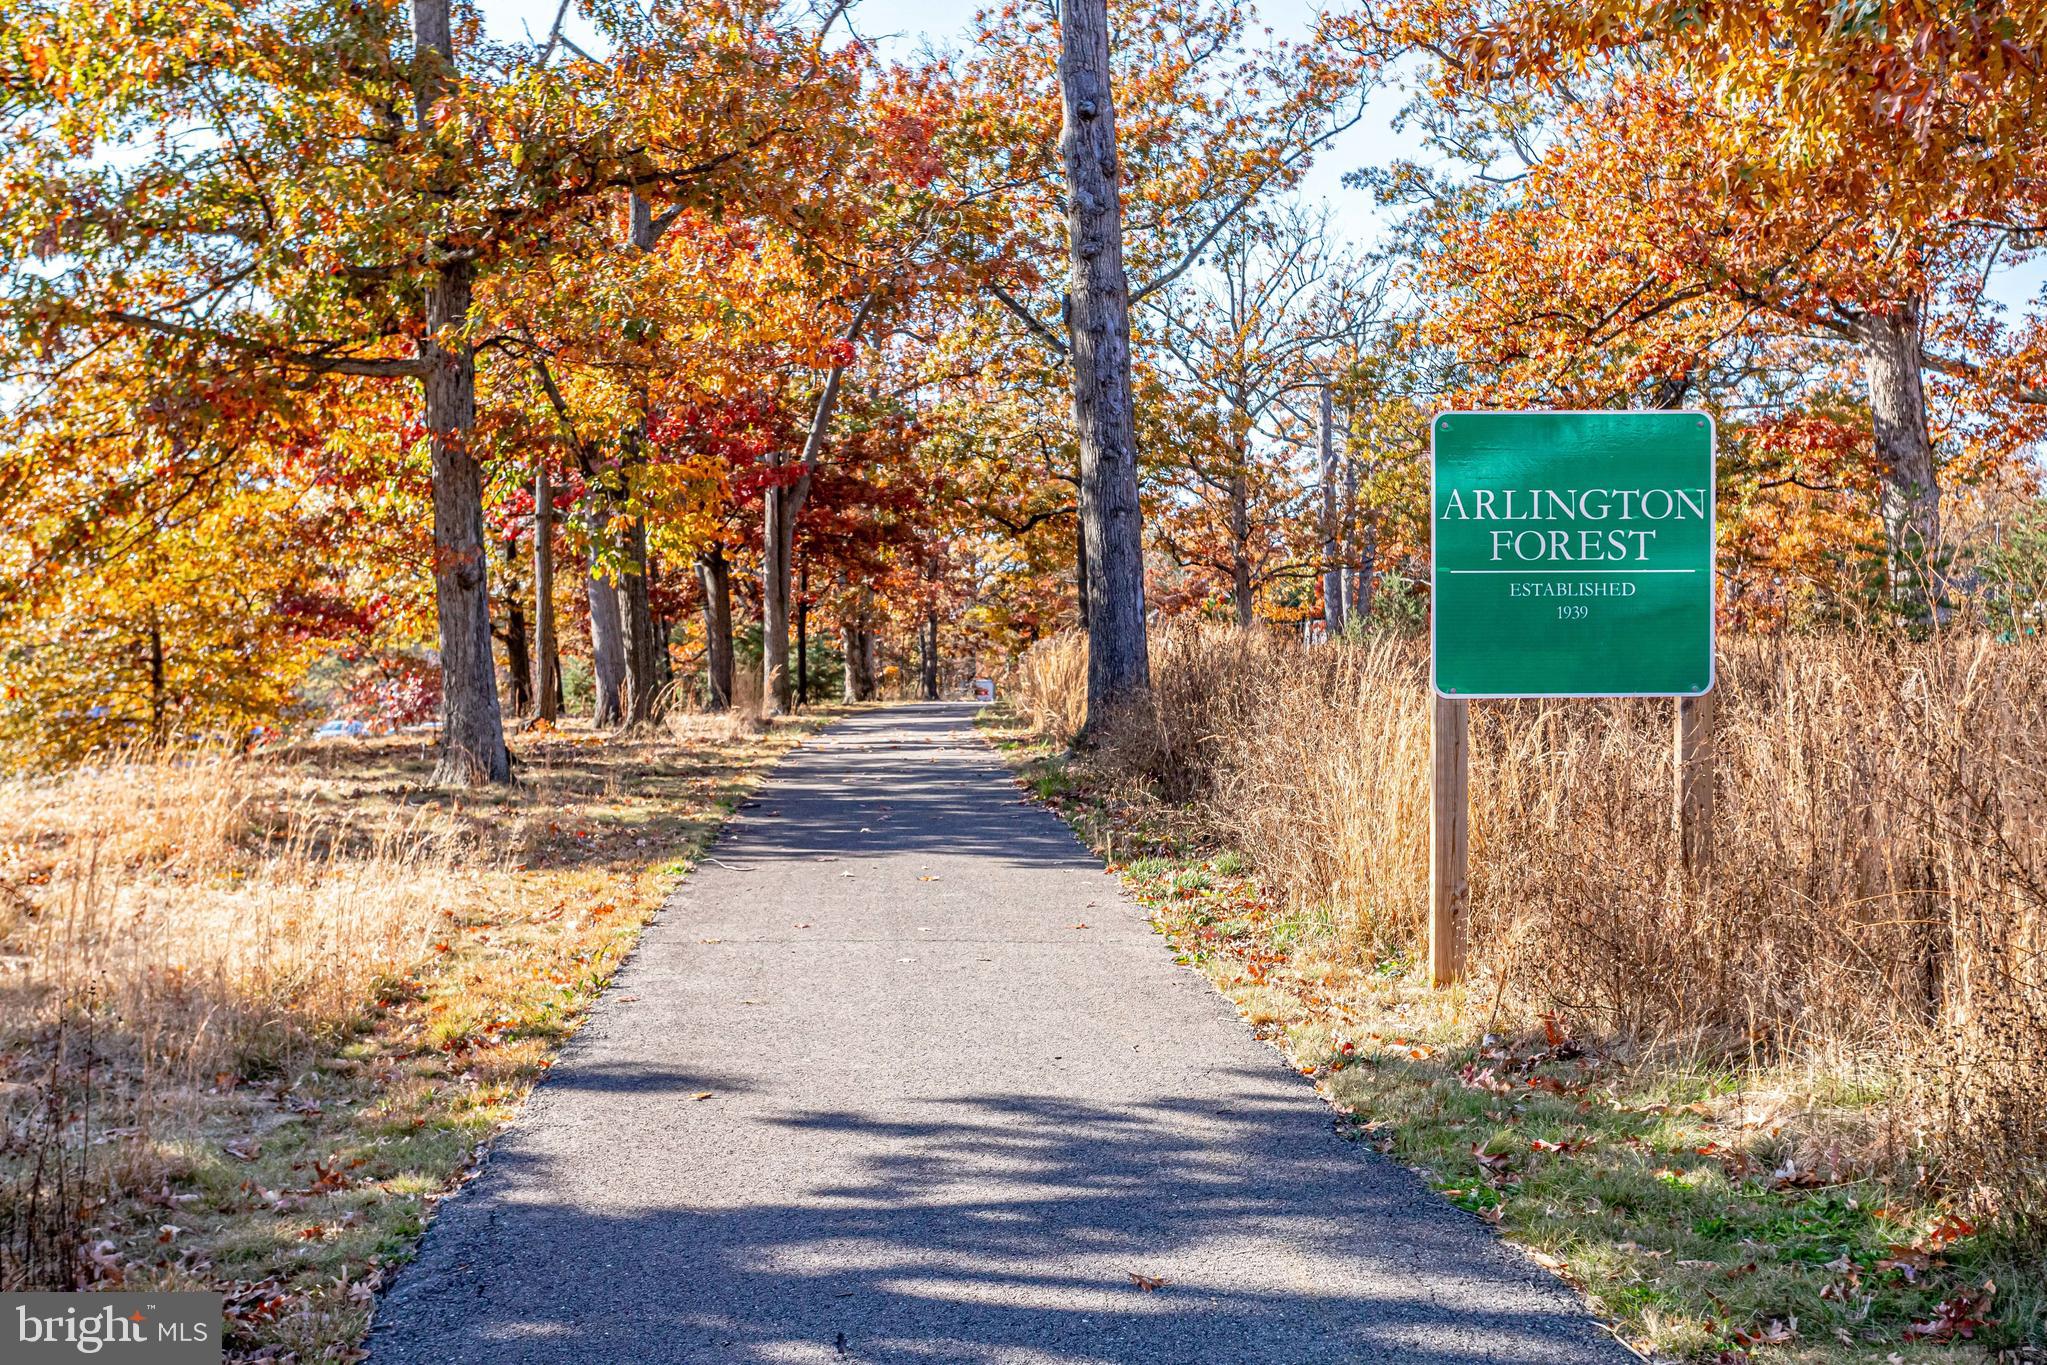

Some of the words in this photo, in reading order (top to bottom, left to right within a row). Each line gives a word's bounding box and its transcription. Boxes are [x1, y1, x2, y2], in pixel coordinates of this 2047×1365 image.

[1440, 488, 1707, 521] ARLINGTON
[1489, 529, 1657, 561] FOREST
[1509, 582, 1636, 597] ESTABLISHED
[1556, 605, 1589, 620] 1939
